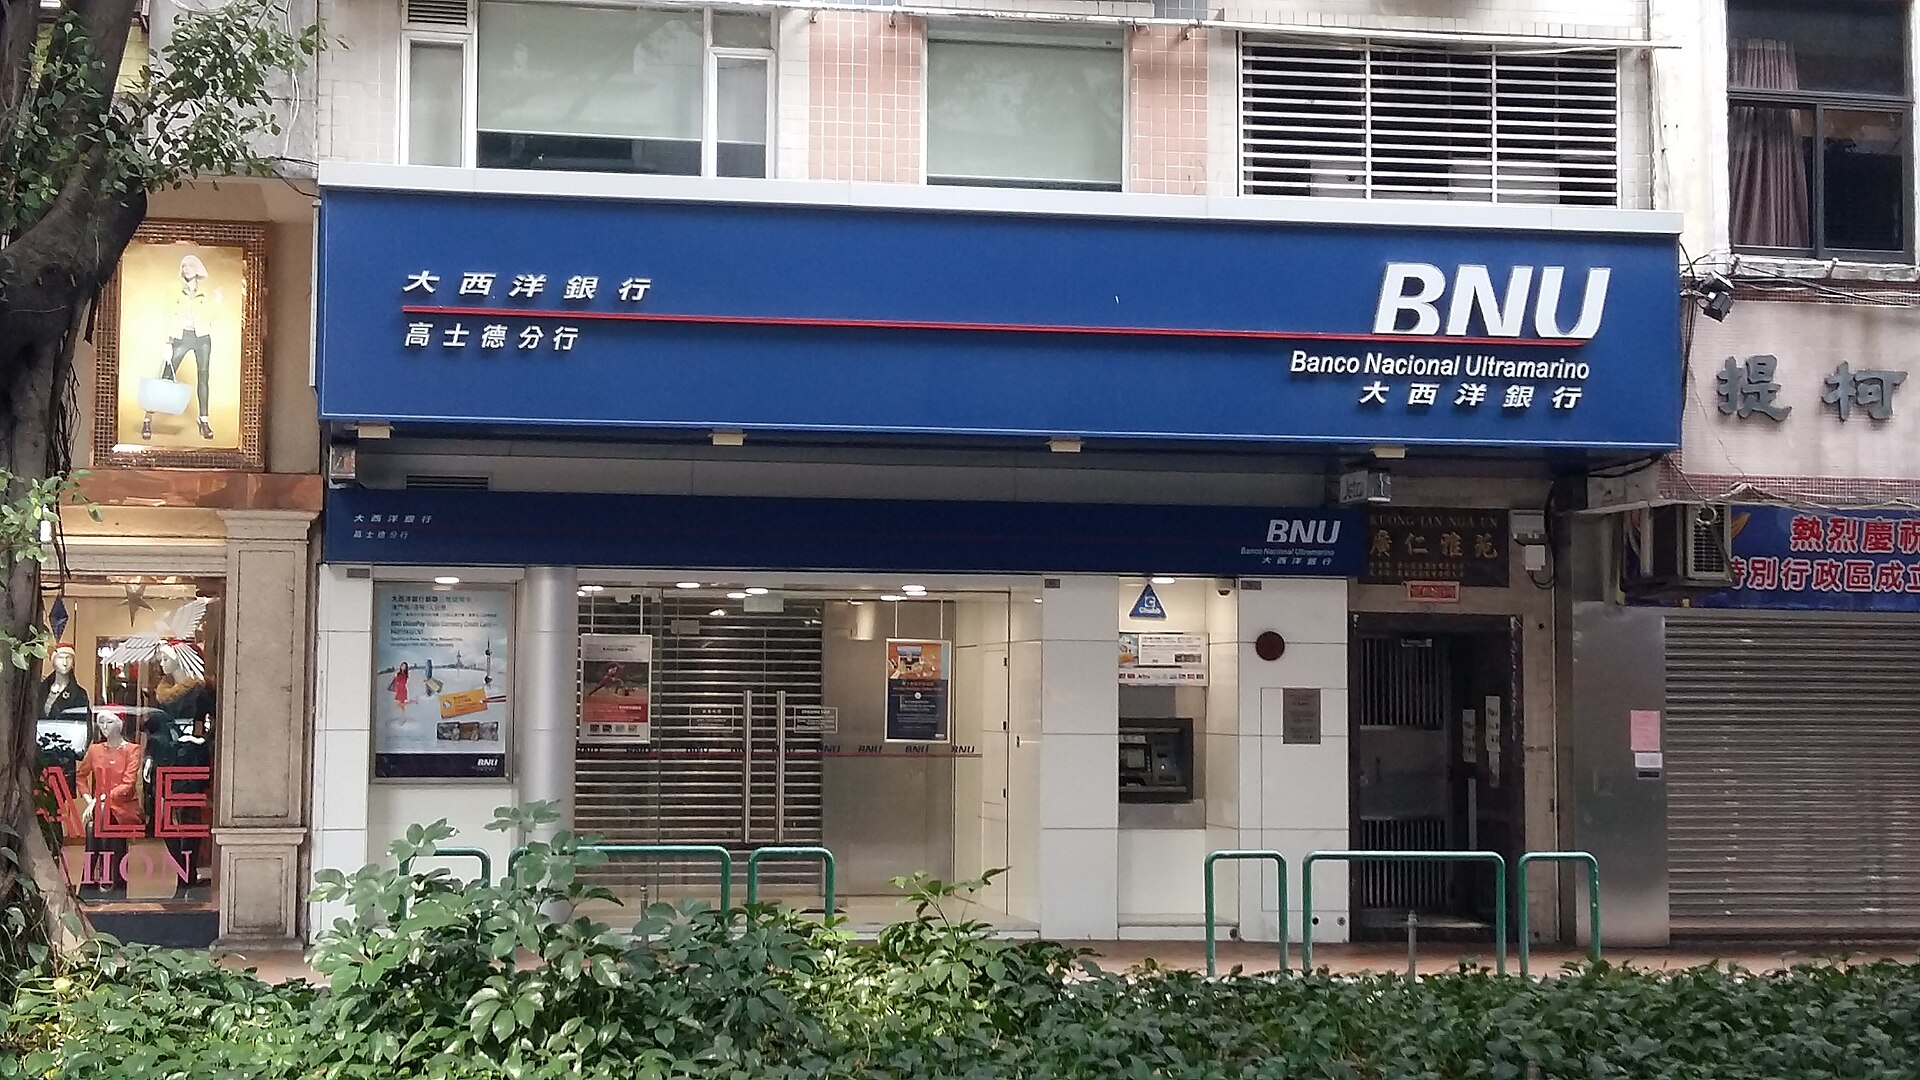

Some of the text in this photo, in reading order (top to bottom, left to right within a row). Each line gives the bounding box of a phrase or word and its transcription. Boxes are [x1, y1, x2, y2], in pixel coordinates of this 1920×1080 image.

[402, 270, 652, 302] 大西洋銀行
[1373, 261, 1611, 339] BNU
[404, 322, 579, 351] 高士德分行
[1290, 350, 1590, 380] Banco Nacional Ultramarino
[1359, 381, 1583, 410] 大西洋銀行
[1266, 519, 1341, 544] BNU
[1790, 515, 1920, 554] 熱烈慶祝
